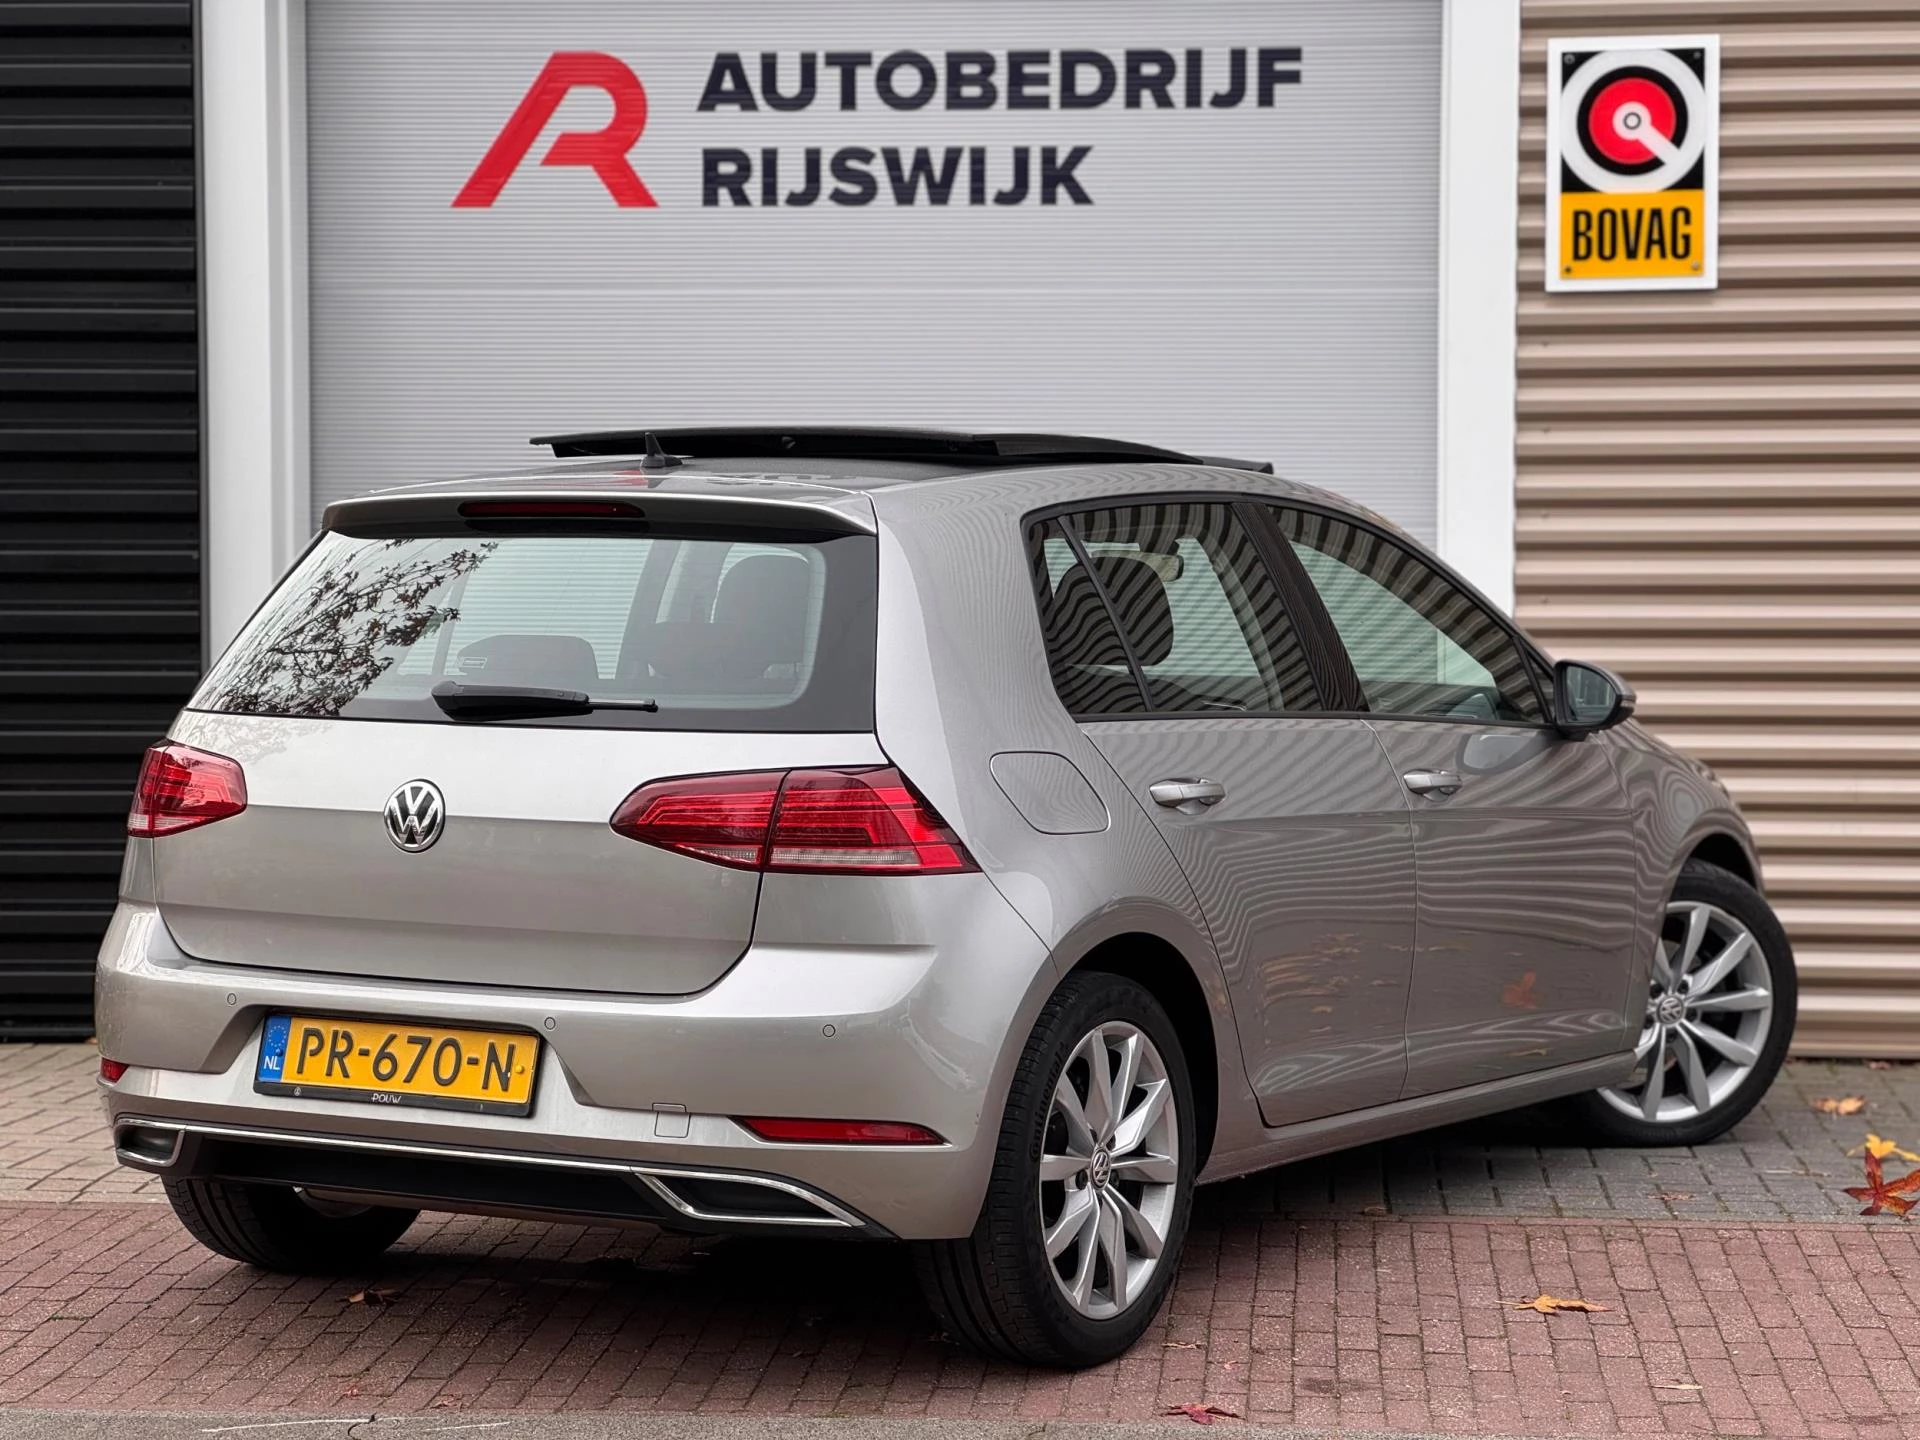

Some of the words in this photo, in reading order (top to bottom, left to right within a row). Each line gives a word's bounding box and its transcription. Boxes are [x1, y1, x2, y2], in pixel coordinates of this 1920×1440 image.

[697, 47, 1303, 112] AUTOBEDRIJF
[702, 146, 1095, 208] RIJSWIJK
[1572, 206, 1692, 262] BOVAG
[385, 780, 444, 851] VW
[263, 1055, 281, 1070] NL
[296, 1026, 516, 1092] PR-670-N
